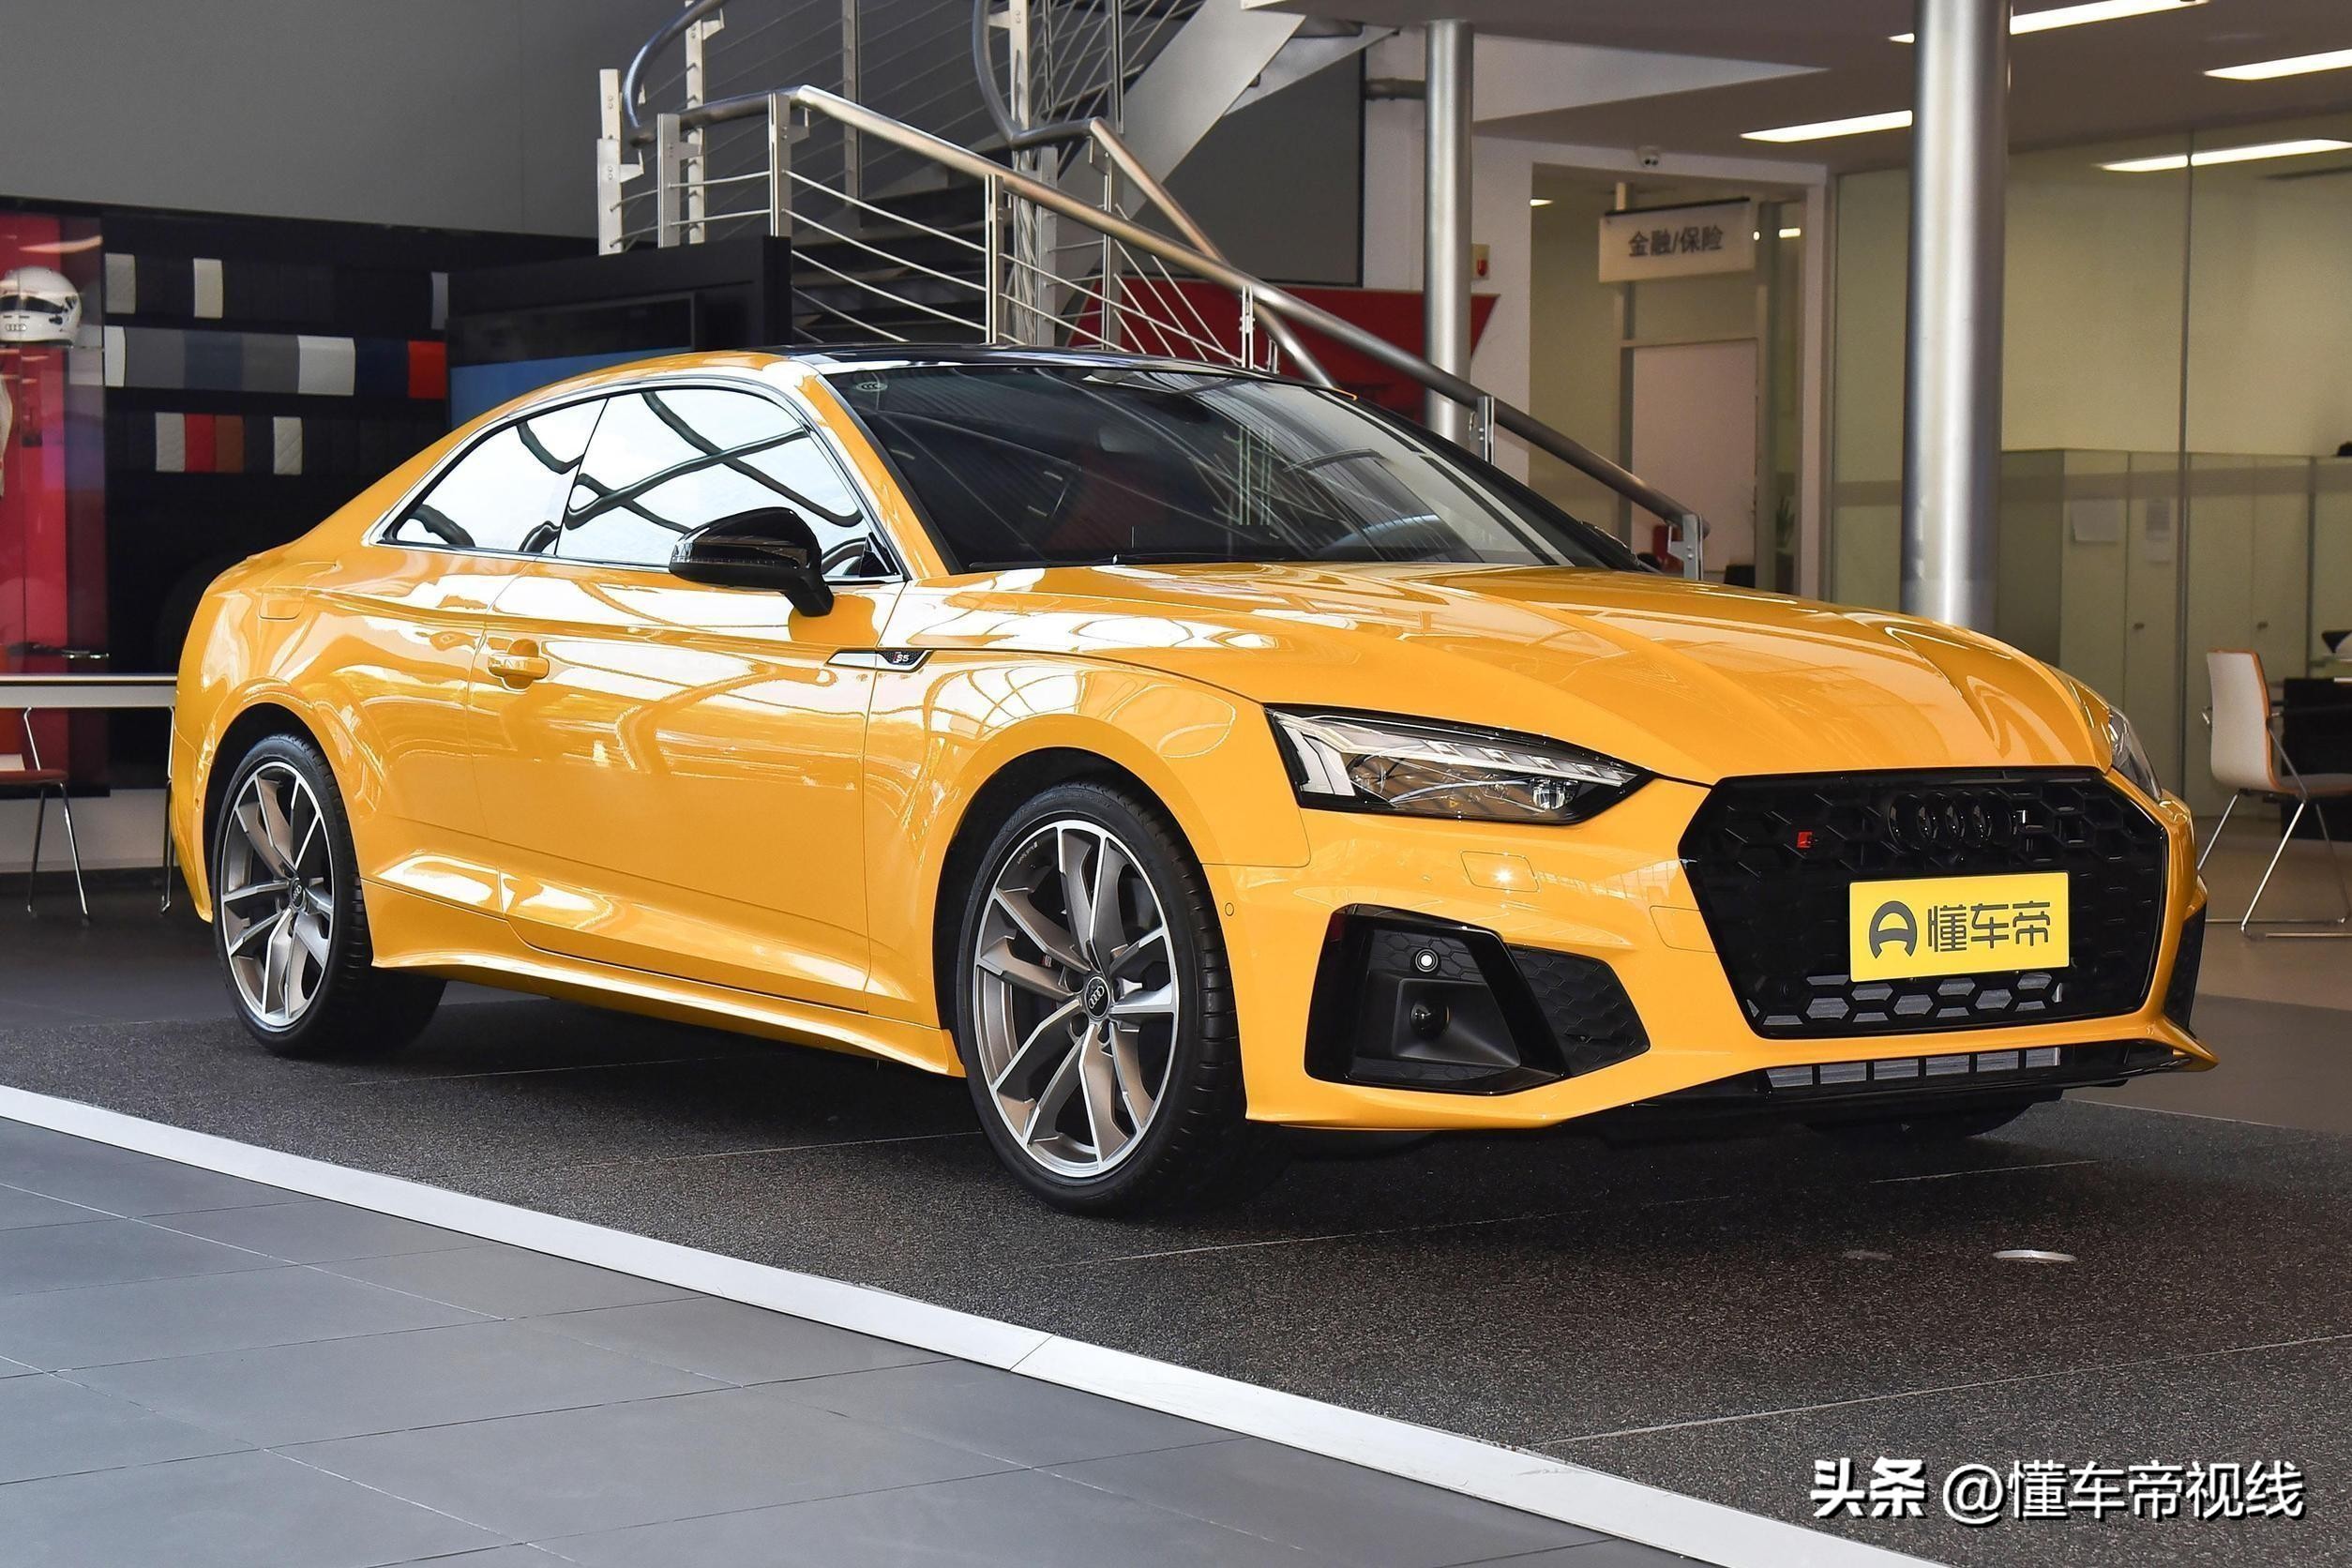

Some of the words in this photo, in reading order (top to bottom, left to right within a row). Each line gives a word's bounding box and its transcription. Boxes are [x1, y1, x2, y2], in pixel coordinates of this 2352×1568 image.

[1628, 225, 1724, 257] 金融/保险
[1927, 900, 2051, 953] 懂车帝
